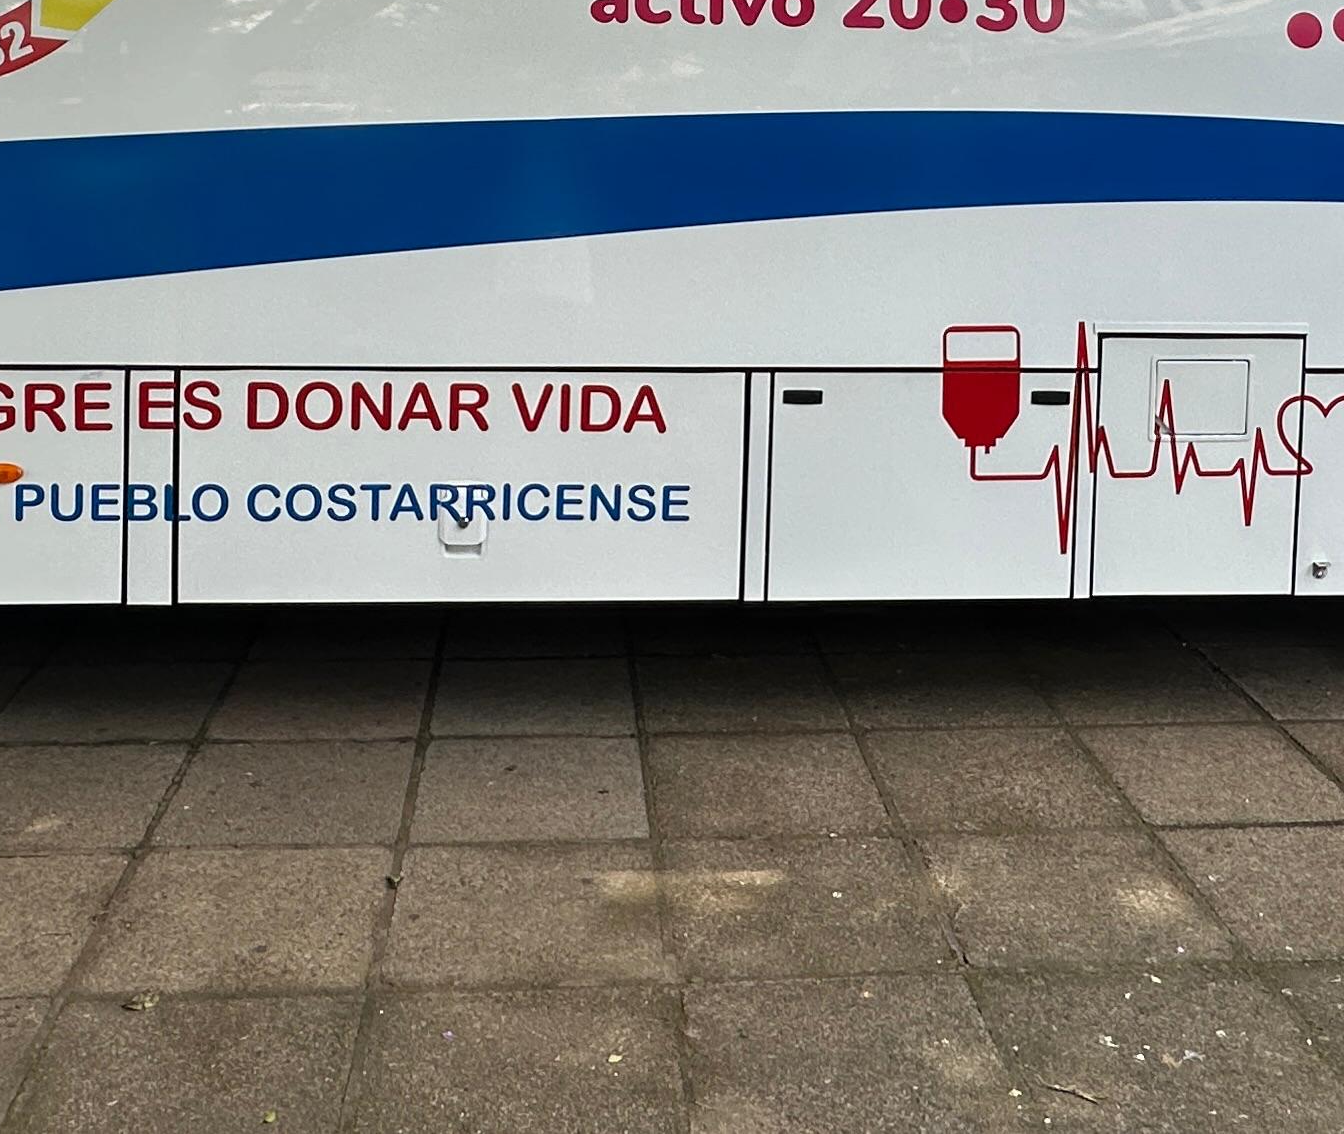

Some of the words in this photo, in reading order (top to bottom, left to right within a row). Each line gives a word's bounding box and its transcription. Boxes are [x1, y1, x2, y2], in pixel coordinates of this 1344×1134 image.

[137, 380, 223, 431] ES
[245, 381, 491, 433] DONAR
[510, 382, 667, 434] VIDA
[13, 483, 230, 523] PUEBLO
[245, 483, 691, 523] COSTARRICENSE
